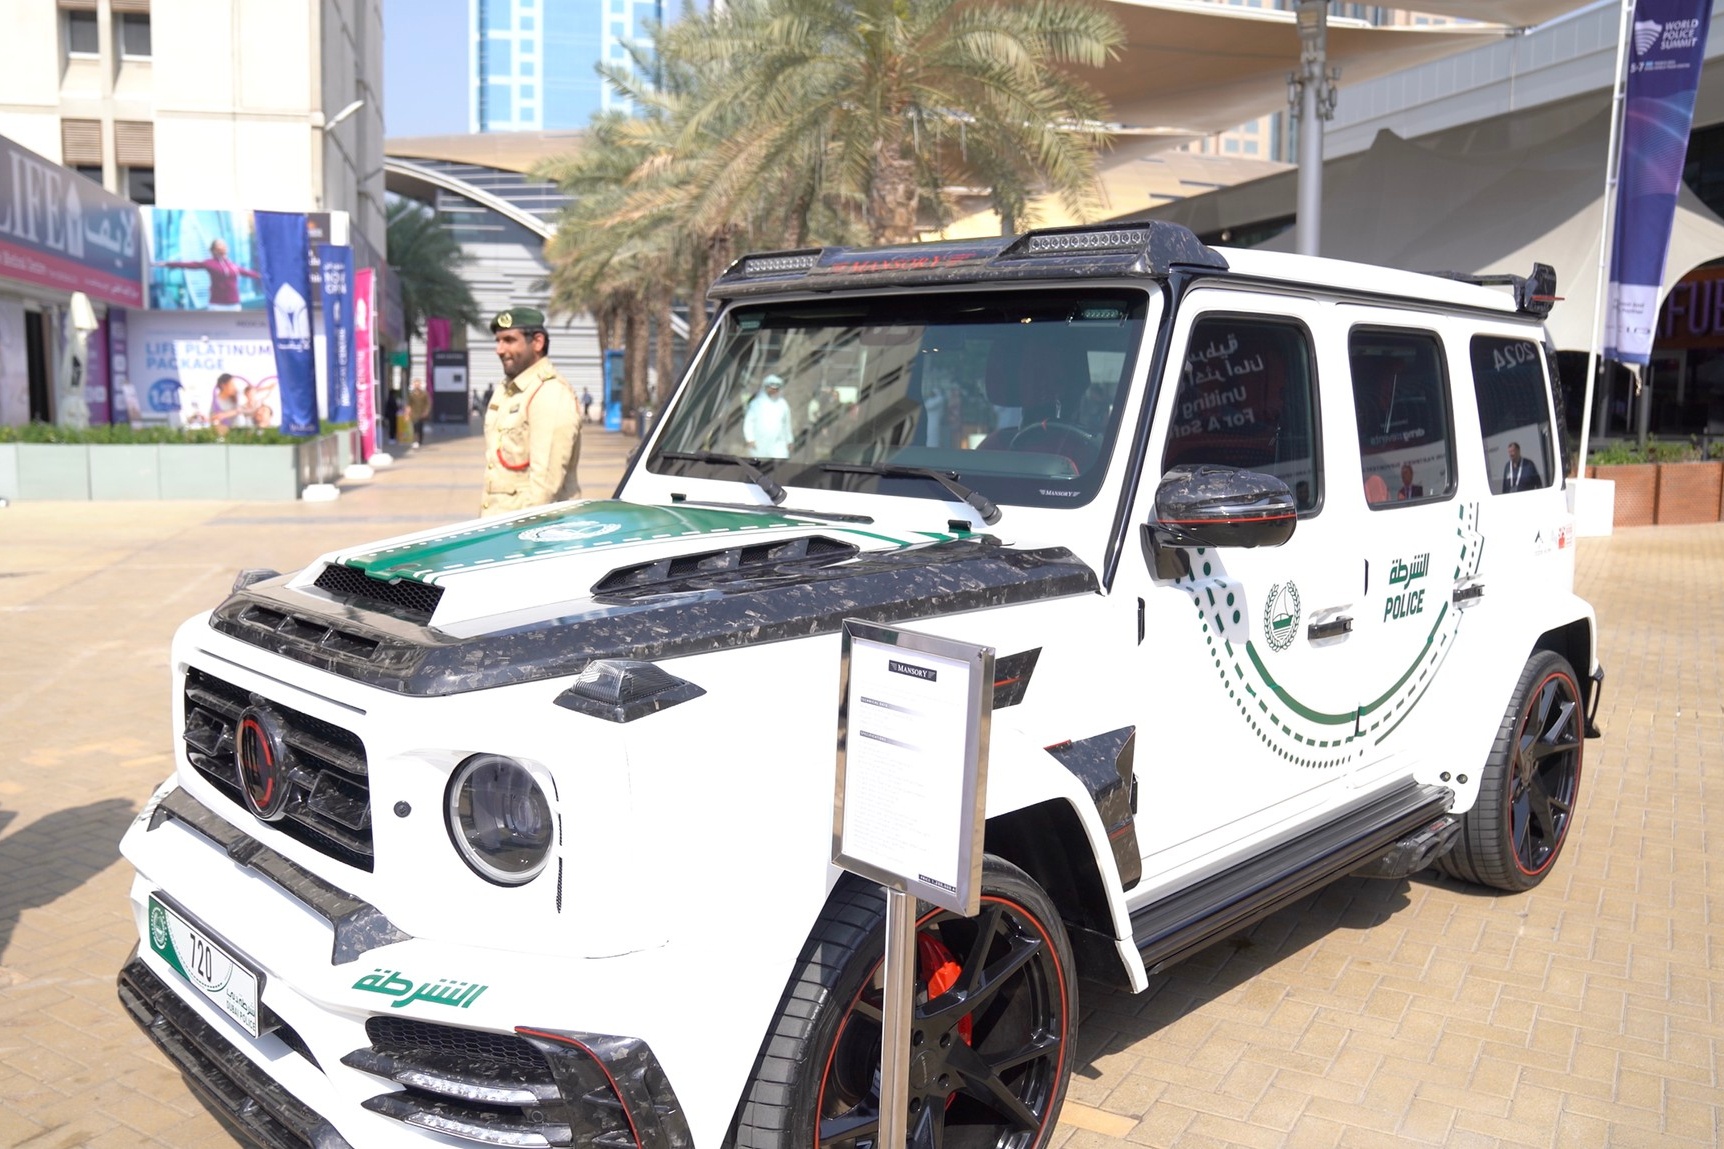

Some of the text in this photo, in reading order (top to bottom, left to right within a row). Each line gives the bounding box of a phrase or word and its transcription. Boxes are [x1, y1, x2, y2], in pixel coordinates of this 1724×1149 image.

[1665, 18, 1699, 31] WORLD
[1662, 28, 1695, 40] POLICE
[1660, 36, 1698, 50] SUMMIT
[145, 343, 272, 356] LIFE PLATINUM
[145, 358, 225, 371] PACKAGE
[1389, 552, 1430, 590] الشرطة
[1383, 588, 1425, 623] POLICE
[897, 664, 928, 678] MANSORY
[190, 932, 212, 982] 720
[351, 968, 490, 1009] الشرطة
